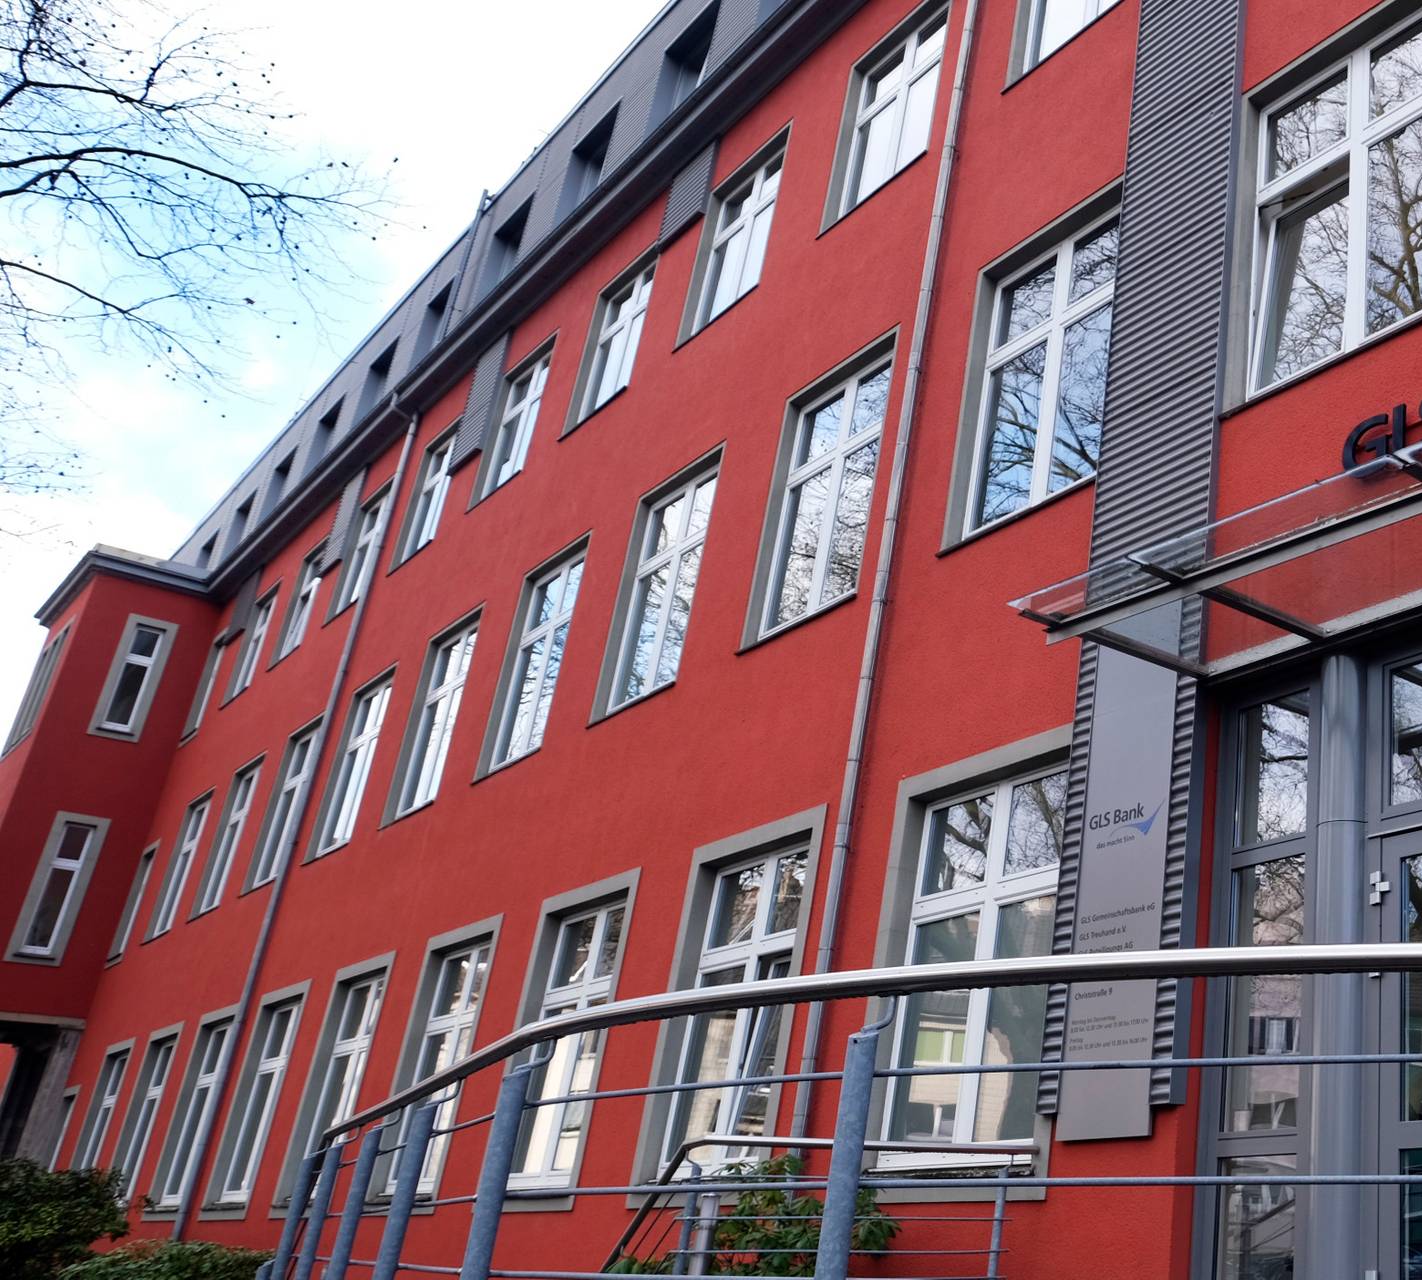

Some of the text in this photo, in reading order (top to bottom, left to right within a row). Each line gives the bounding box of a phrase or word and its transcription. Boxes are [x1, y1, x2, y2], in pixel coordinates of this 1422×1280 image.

[1089, 802, 1144, 830] GLS Bank
[1081, 916, 1091, 925] GLS
[1147, 902, 1156, 911] eG
[1079, 933, 1090, 942] GLS
[1091, 927, 1116, 938] Treuhand
[1124, 941, 1134, 950] AG
